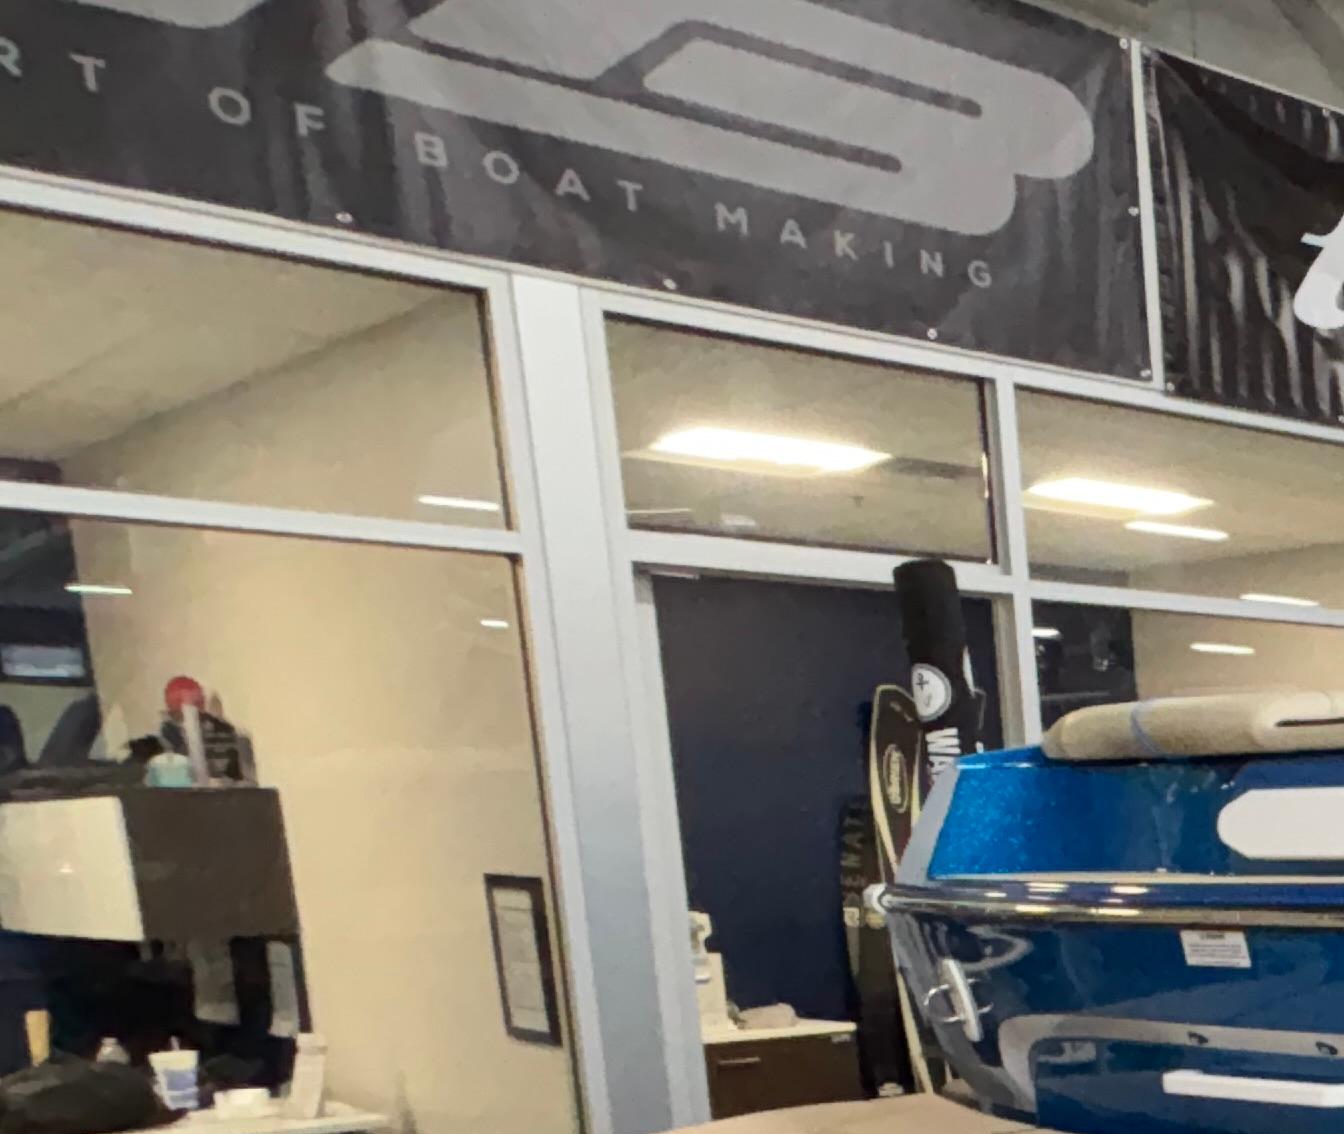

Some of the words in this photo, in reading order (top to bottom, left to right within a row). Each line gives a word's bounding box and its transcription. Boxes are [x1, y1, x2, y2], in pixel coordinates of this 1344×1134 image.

[208, 86, 326, 137] OF
[413, 131, 643, 213] BOAT
[714, 201, 993, 290] MAKING
